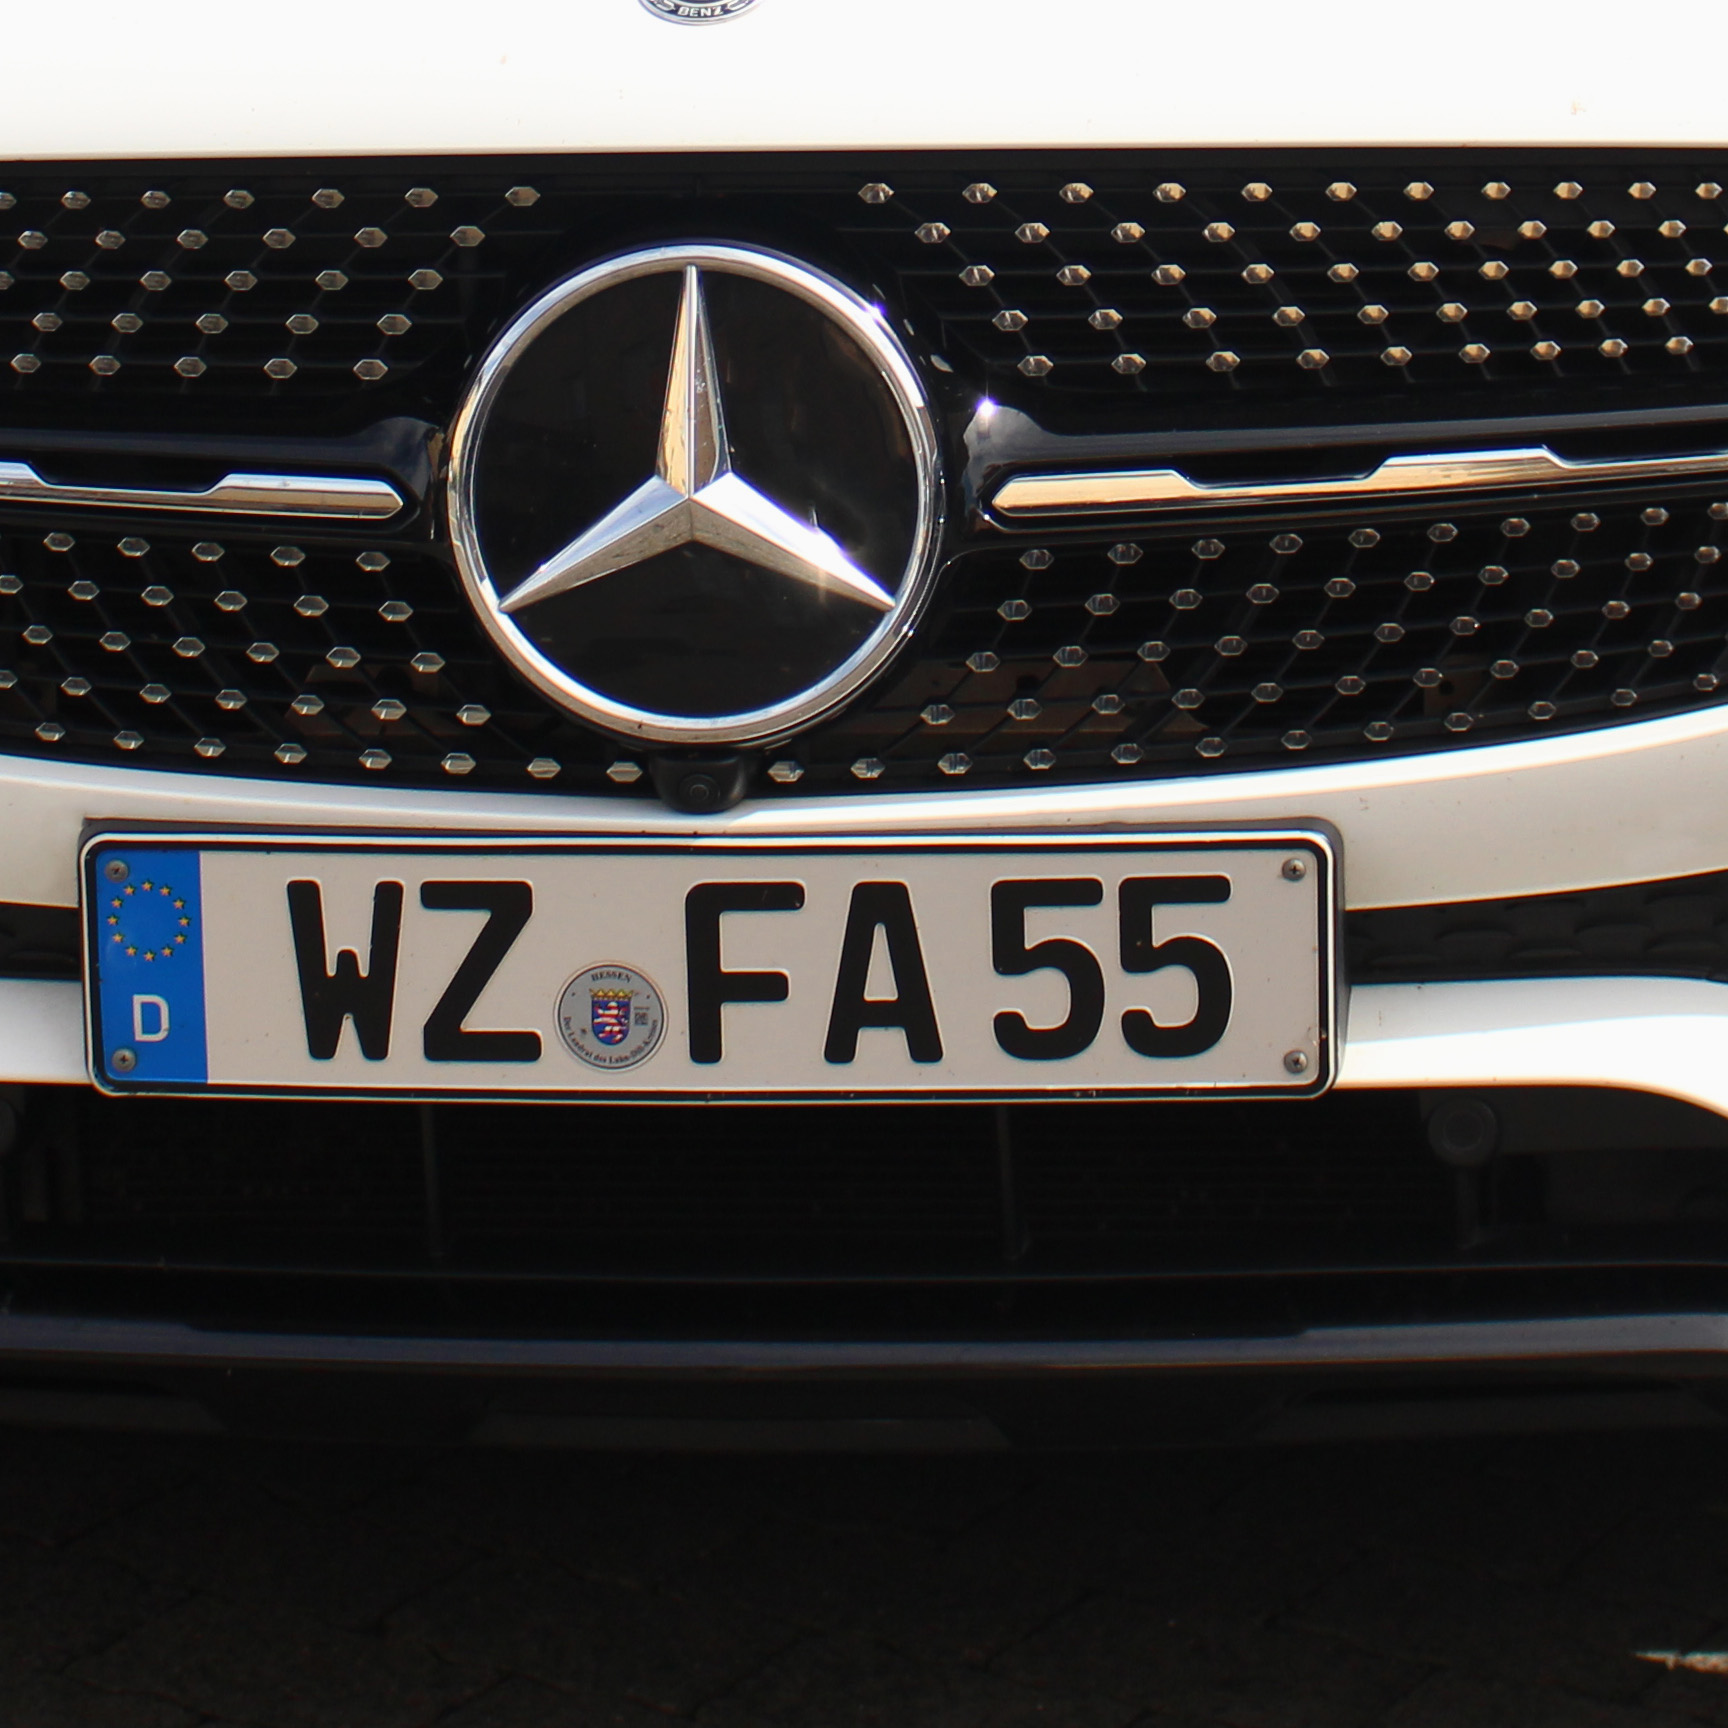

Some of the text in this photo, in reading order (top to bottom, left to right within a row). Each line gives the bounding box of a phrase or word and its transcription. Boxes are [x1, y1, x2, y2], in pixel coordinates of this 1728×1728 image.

[677, 5, 725, 17] BENZ
[285, 875, 1233, 1065] WZ FA 55
[591, 970, 633, 983] HESSEN
[132, 994, 170, 1042] D
